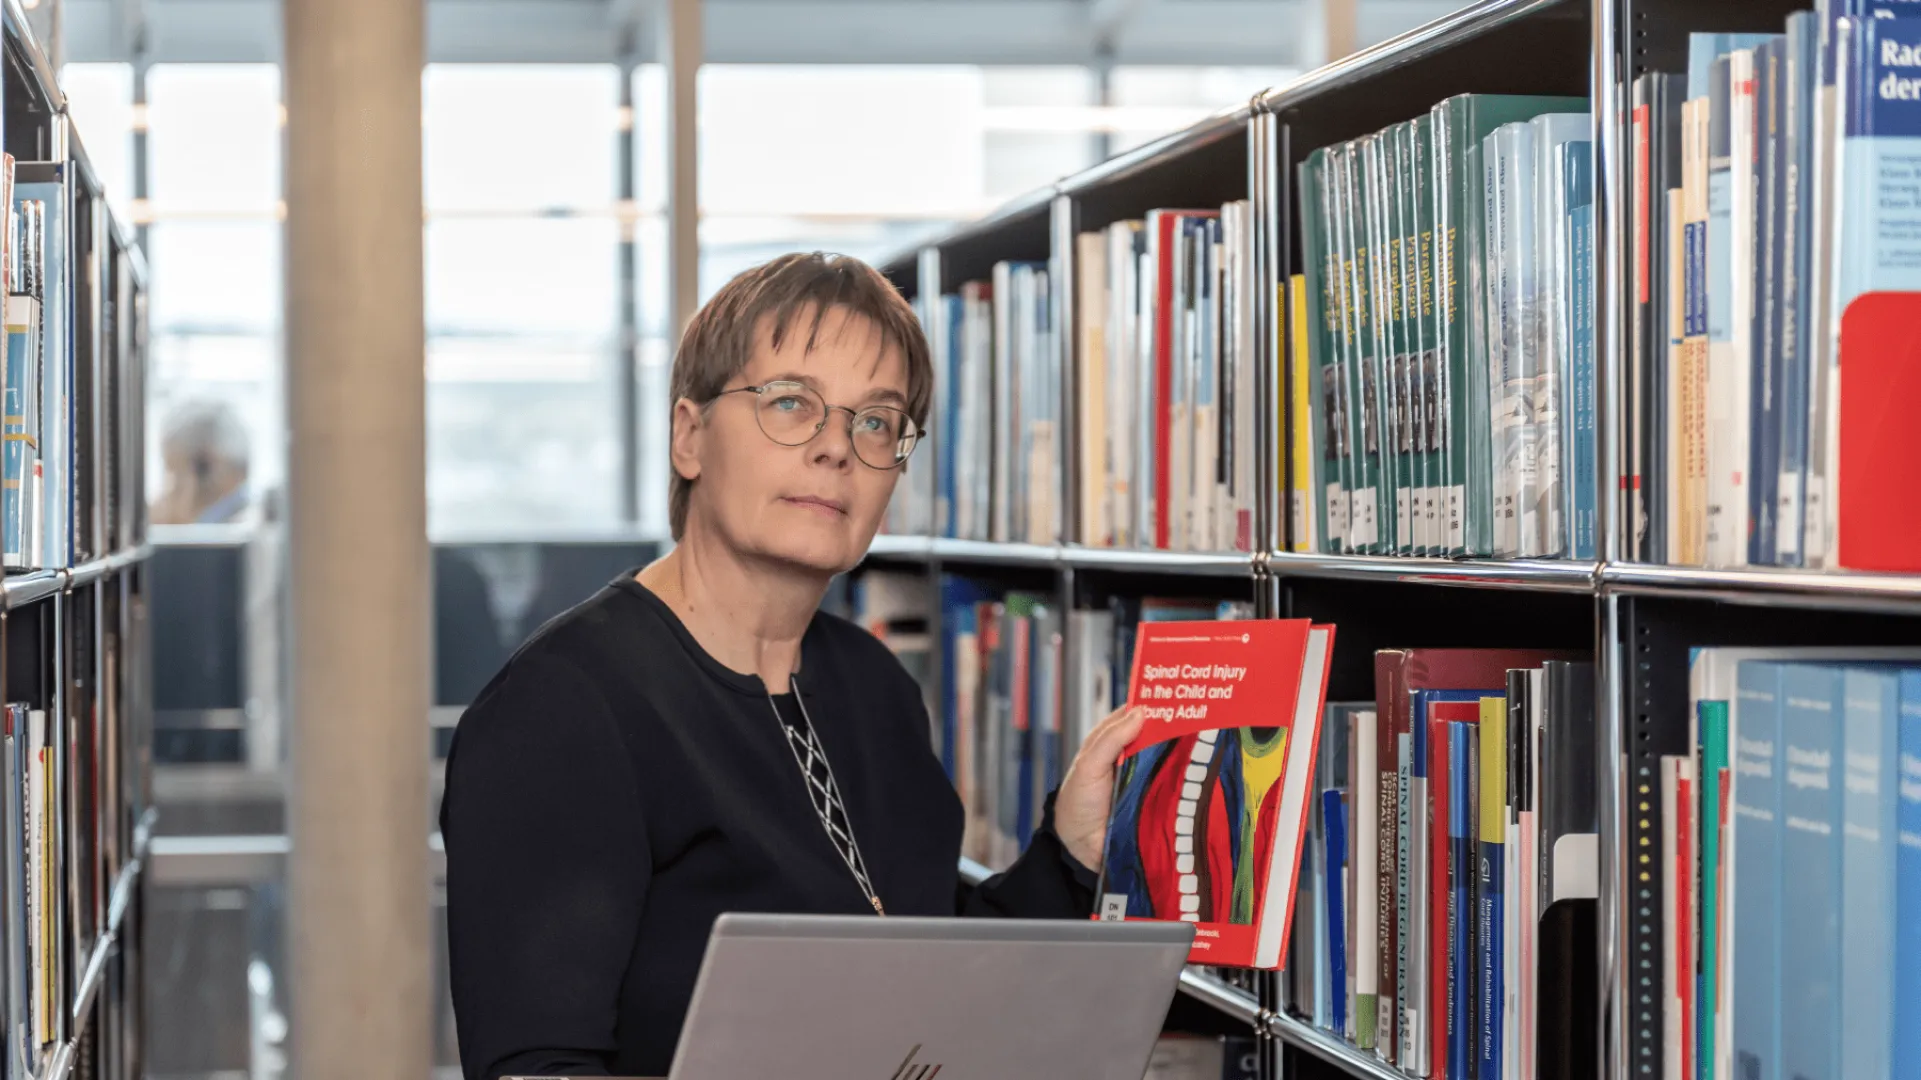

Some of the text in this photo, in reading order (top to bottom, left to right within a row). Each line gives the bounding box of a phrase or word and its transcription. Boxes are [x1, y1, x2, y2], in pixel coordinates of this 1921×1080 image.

[1390, 238, 1402, 321] Paraplegie
[1406, 235, 1417, 319] Paraplegie
[1420, 230, 1433, 316] Paraplegie
[1140, 684, 1234, 699] in the Child and
[1143, 664, 1247, 681] Spinal Cord Injury
[1175, 704, 1208, 719] Adult
[1380, 771, 1388, 826] SPINAL
[1399, 765, 1408, 830] SPINAL
[1399, 835, 1408, 888] CORD
[1379, 877, 1387, 949] INJURIES
[1398, 893, 1407, 1039] REGENERATION
[1484, 969, 1492, 1024] Rehabilitation
[1483, 1035, 1492, 1060] Spinal
